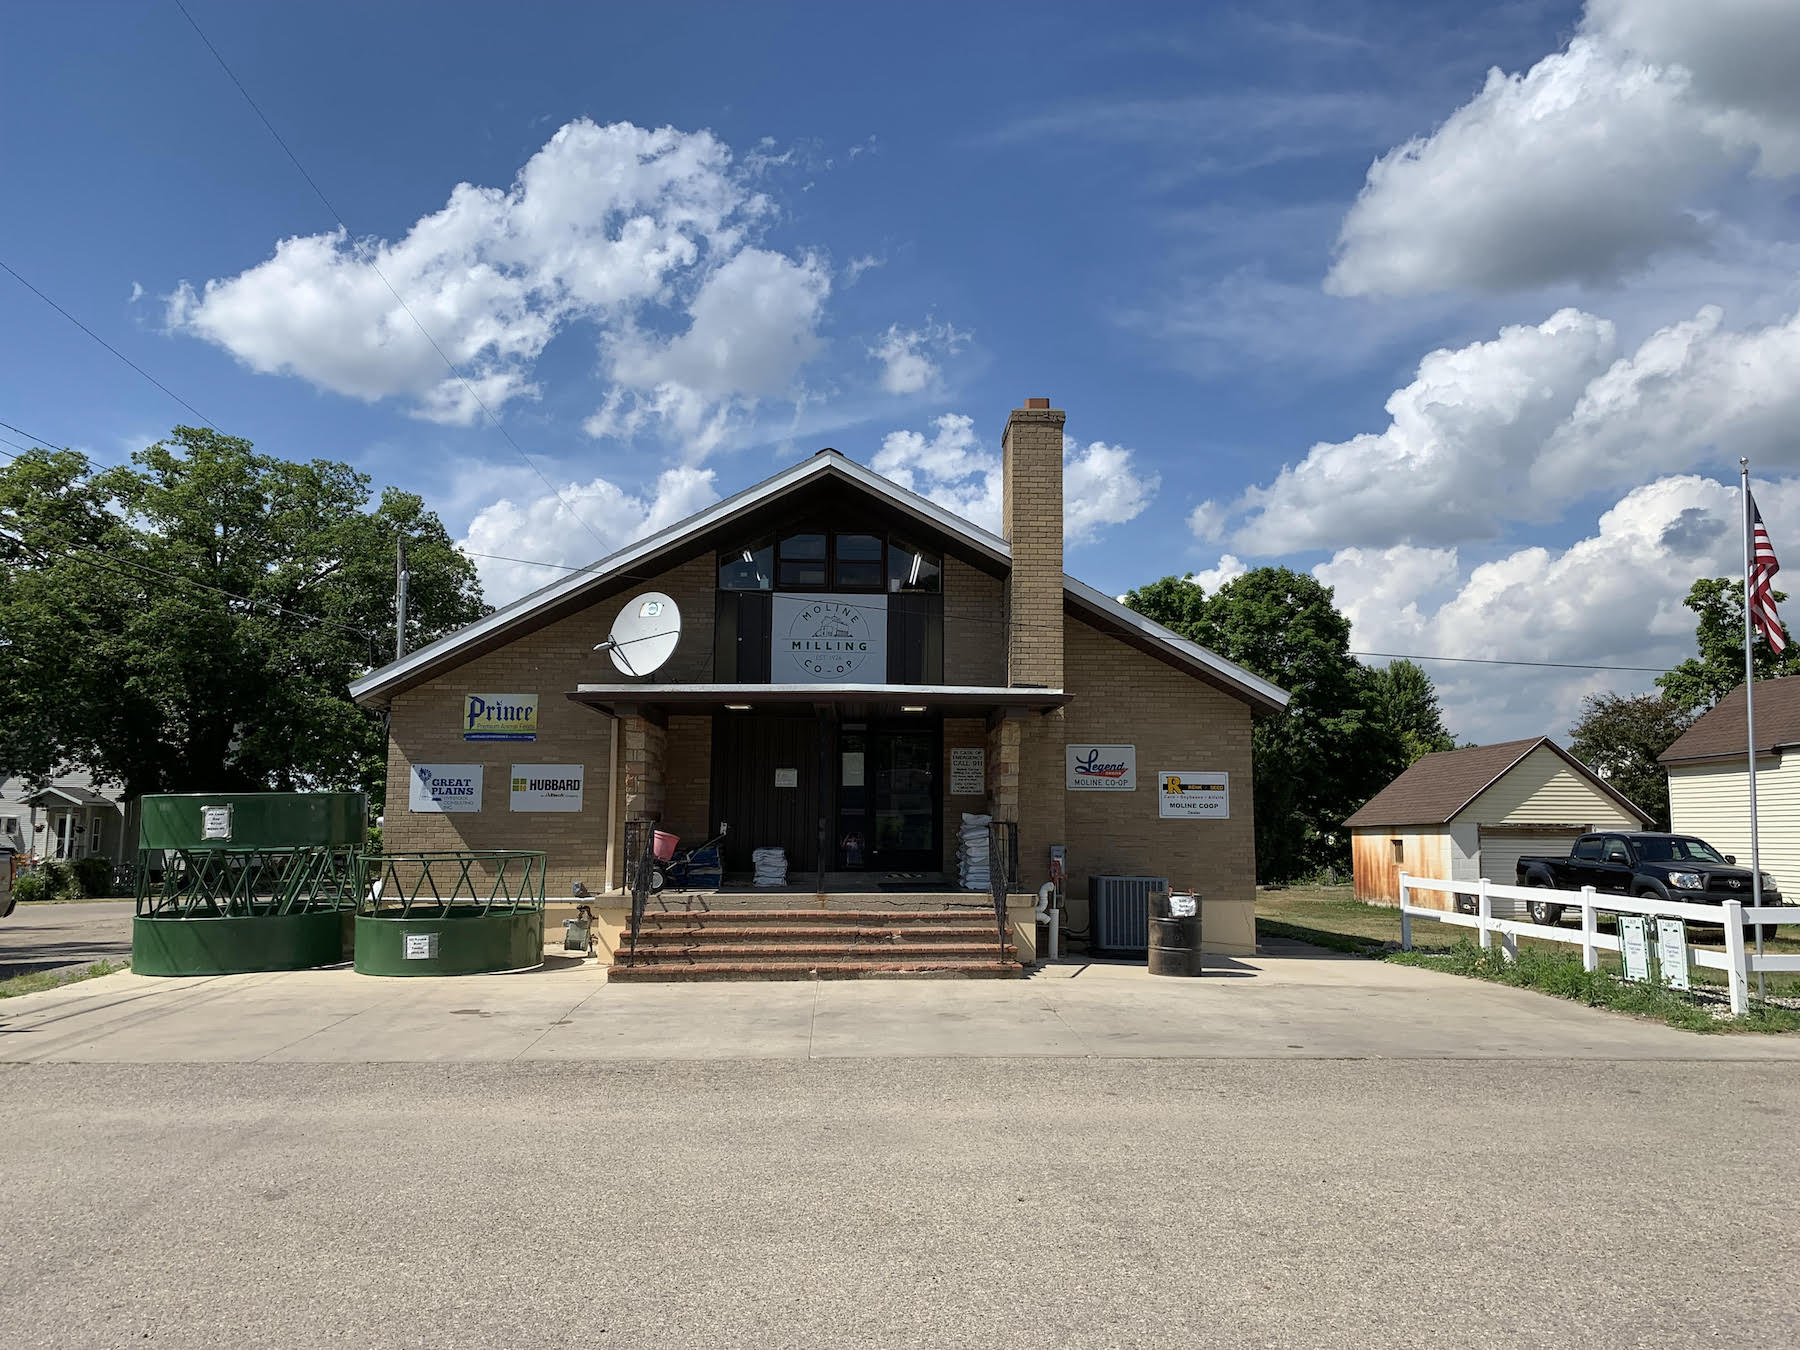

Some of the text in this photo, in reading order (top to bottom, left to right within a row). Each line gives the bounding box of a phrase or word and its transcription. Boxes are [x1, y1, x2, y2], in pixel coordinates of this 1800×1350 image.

[802, 603, 859, 624] MOLINE
[792, 641, 867, 651] MILLING
[467, 695, 533, 730] Prince
[1075, 749, 1125, 774] Legend
[432, 778, 472, 787] GREAT
[529, 779, 580, 791] HUBBARD
[431, 787, 474, 796] PLAINS
